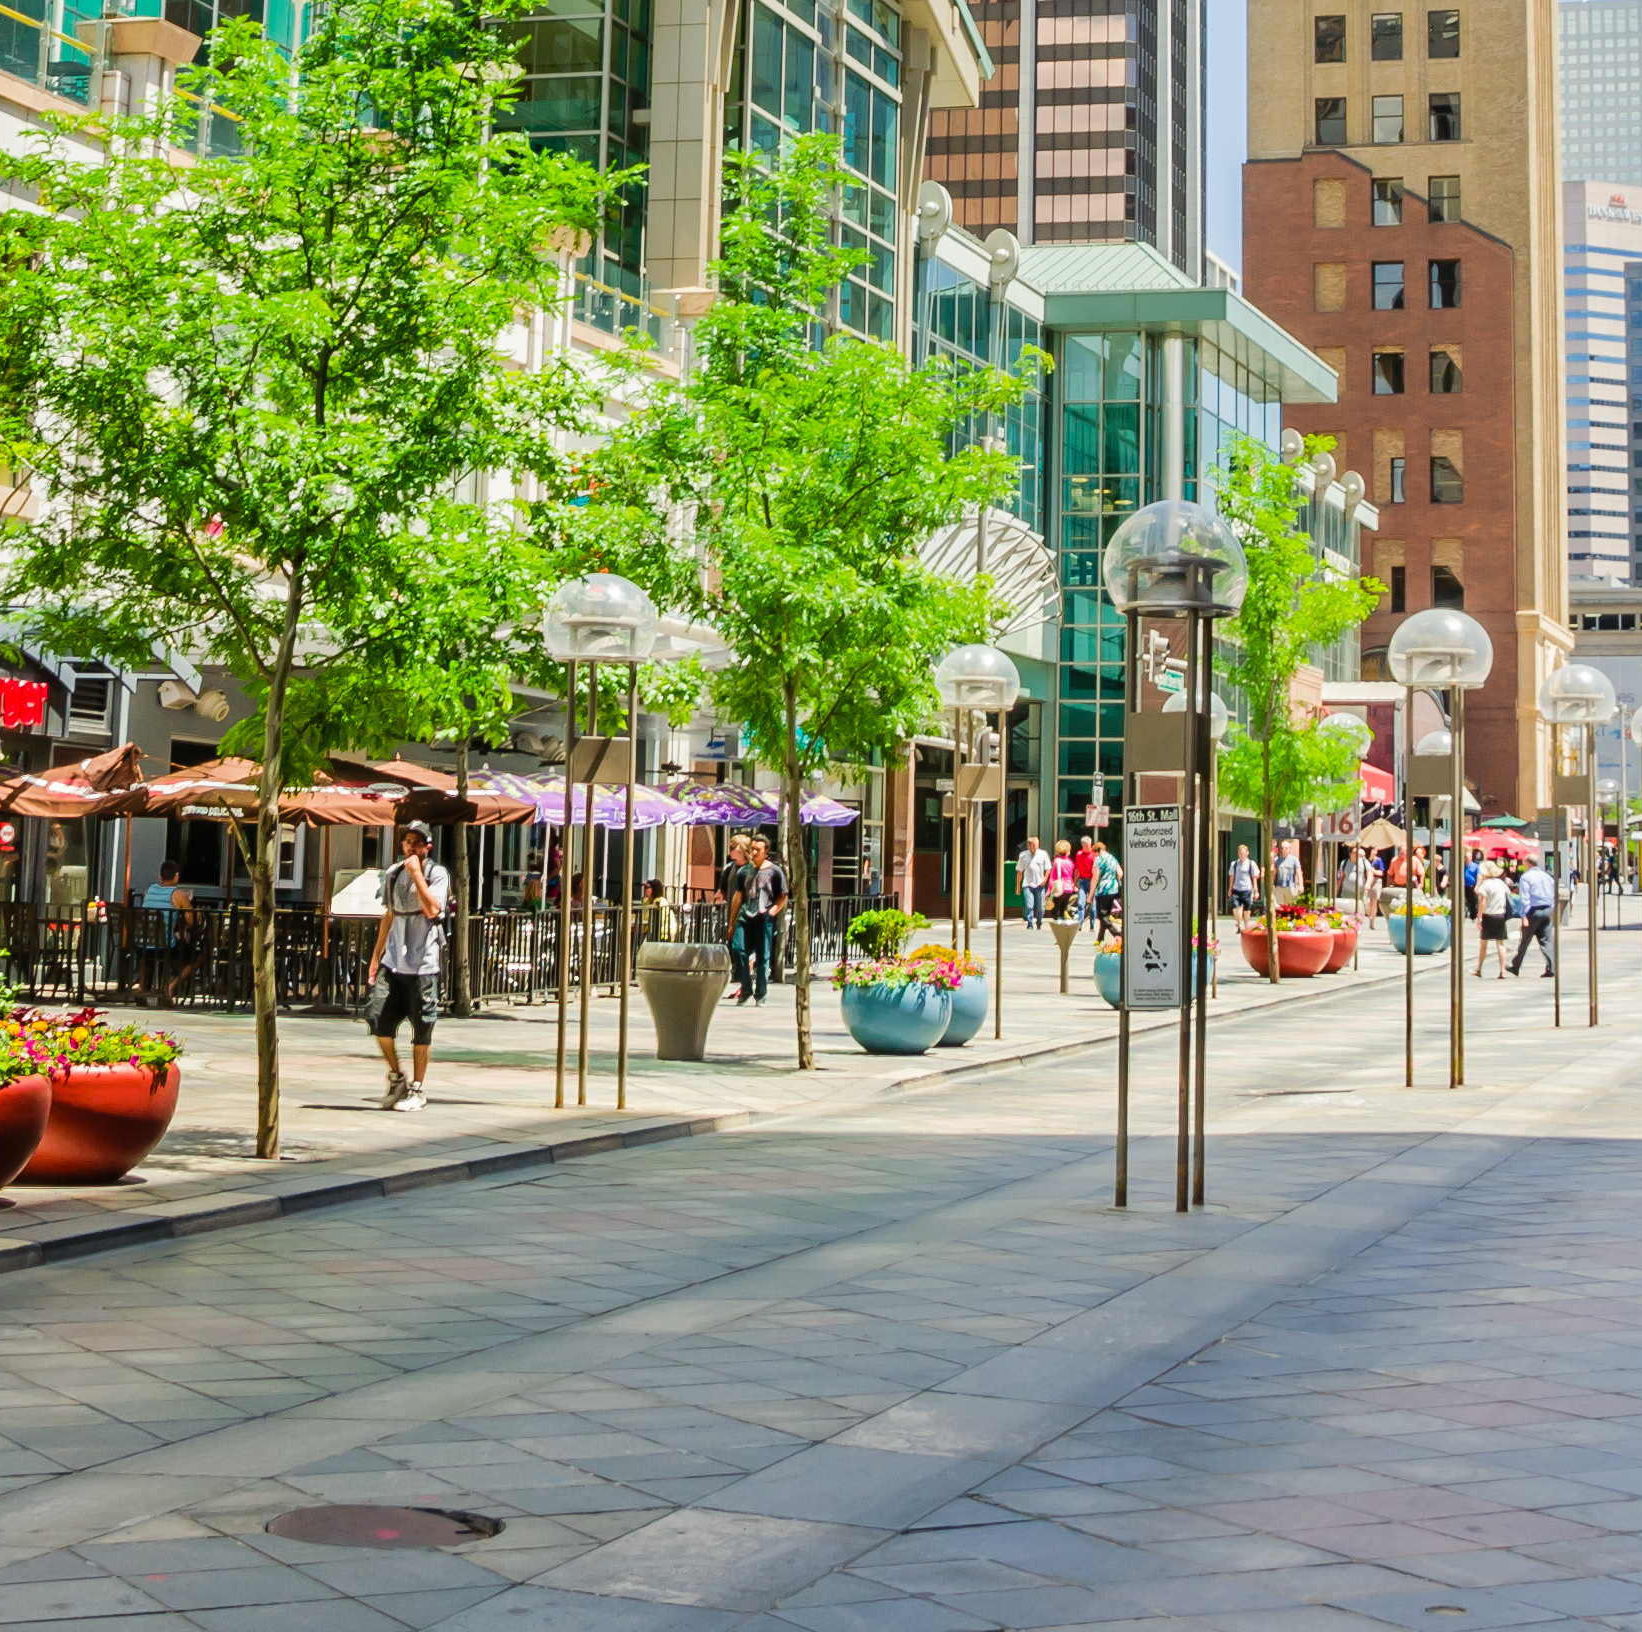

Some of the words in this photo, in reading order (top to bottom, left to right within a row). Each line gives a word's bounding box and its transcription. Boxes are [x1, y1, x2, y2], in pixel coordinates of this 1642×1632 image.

[1127, 810, 1145, 822] 16th
[1147, 809, 1158, 821] St.
[1160, 808, 1179, 820] Mall
[1327, 812, 1354, 835] 16
[1133, 825, 1173, 836] Authorized
[1129, 838, 1158, 848] Vehicles
[1160, 837, 1177, 849] Only
